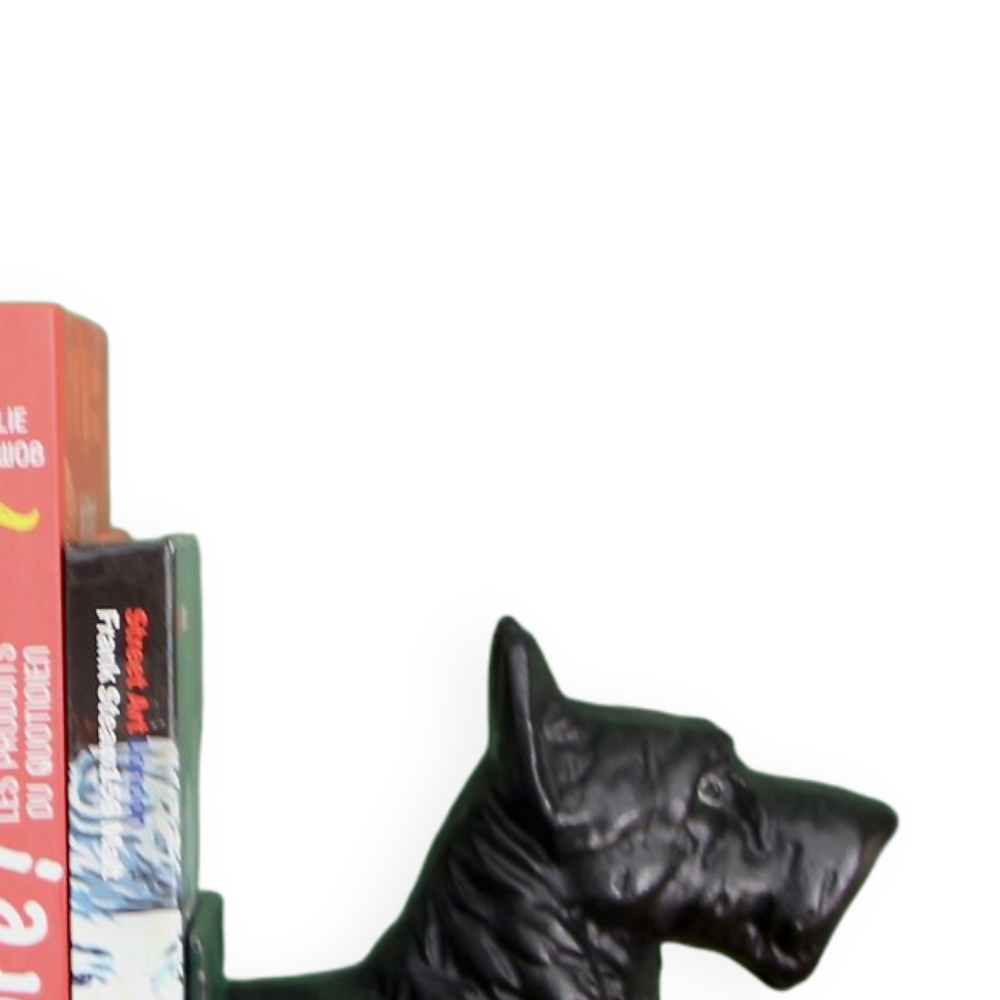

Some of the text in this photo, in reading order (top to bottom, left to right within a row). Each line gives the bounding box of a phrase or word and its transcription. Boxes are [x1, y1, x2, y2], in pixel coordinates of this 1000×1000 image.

[96, 608, 121, 684] Frank
[125, 606, 149, 690] Street
[23, 645, 53, 820] DU QUOTIDIEN
[126, 692, 150, 735] Art
